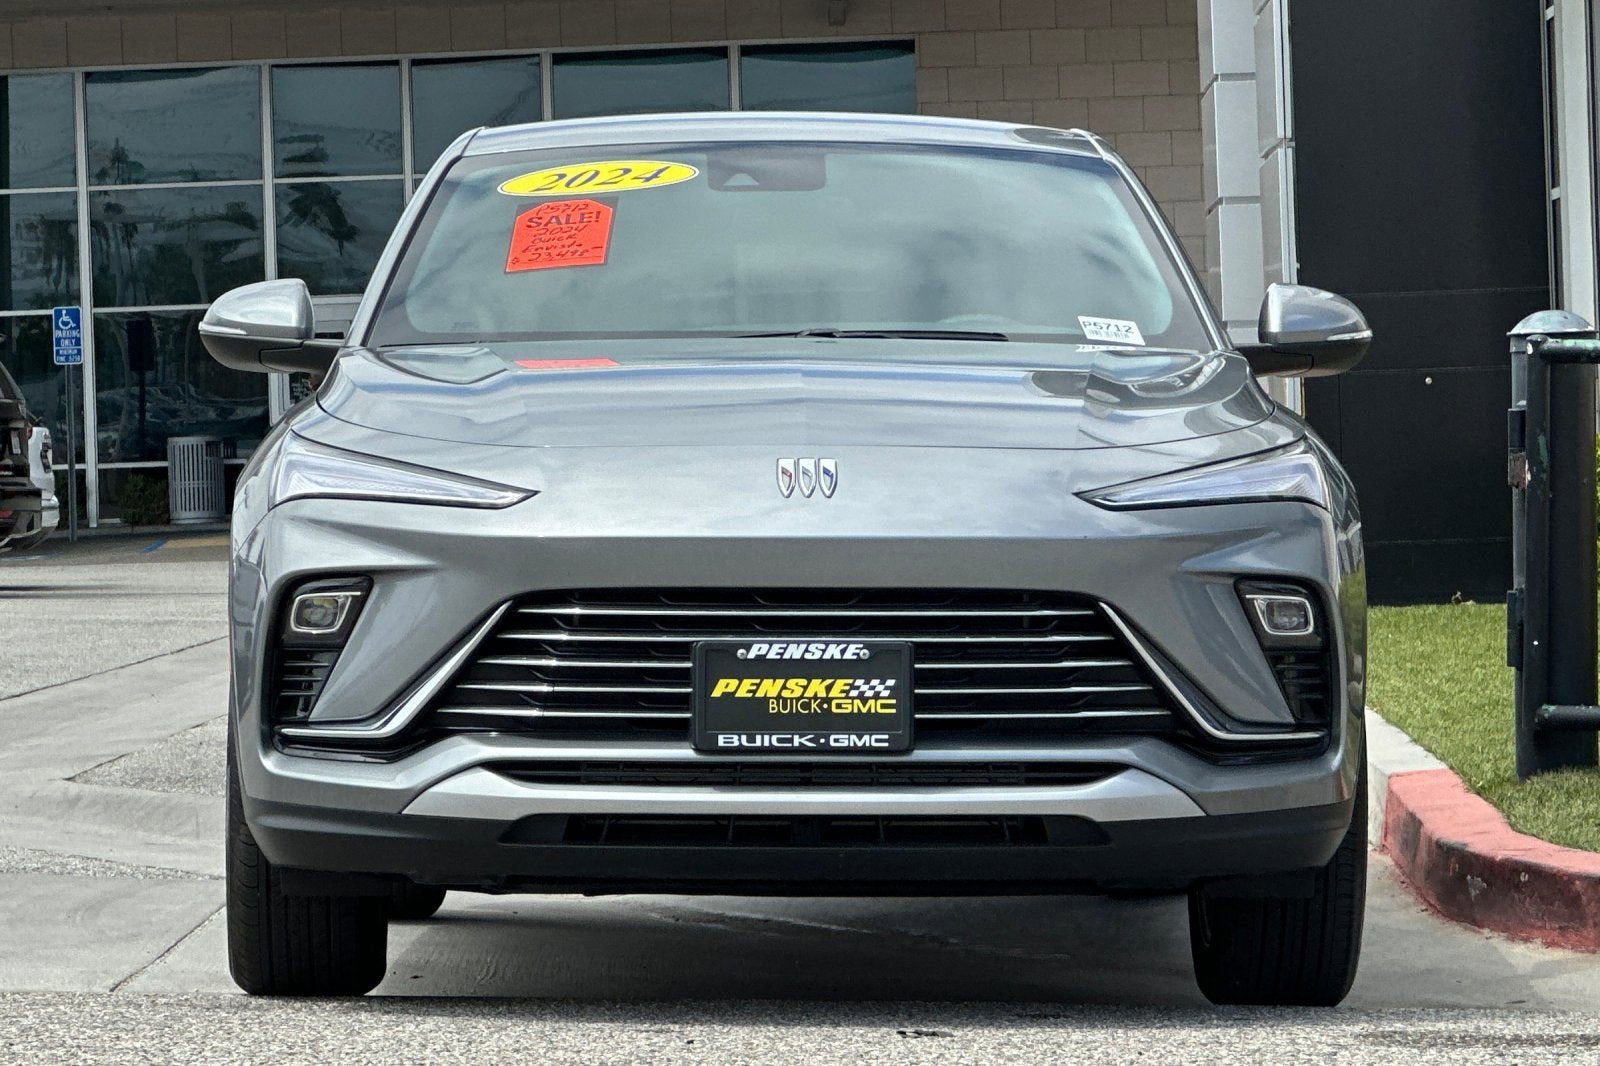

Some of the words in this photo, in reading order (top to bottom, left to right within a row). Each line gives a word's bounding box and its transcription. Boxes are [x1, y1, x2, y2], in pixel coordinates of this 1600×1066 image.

[530, 166, 671, 192] 2024
[526, 211, 601, 228] SALE!
[533, 224, 588, 237] 2024
[55, 329, 80, 338] PARKING
[1082, 320, 1134, 334] P5712
[61, 339, 75, 347] ONLY
[747, 643, 863, 660] PENSKE
[710, 678, 855, 698] PENSKE
